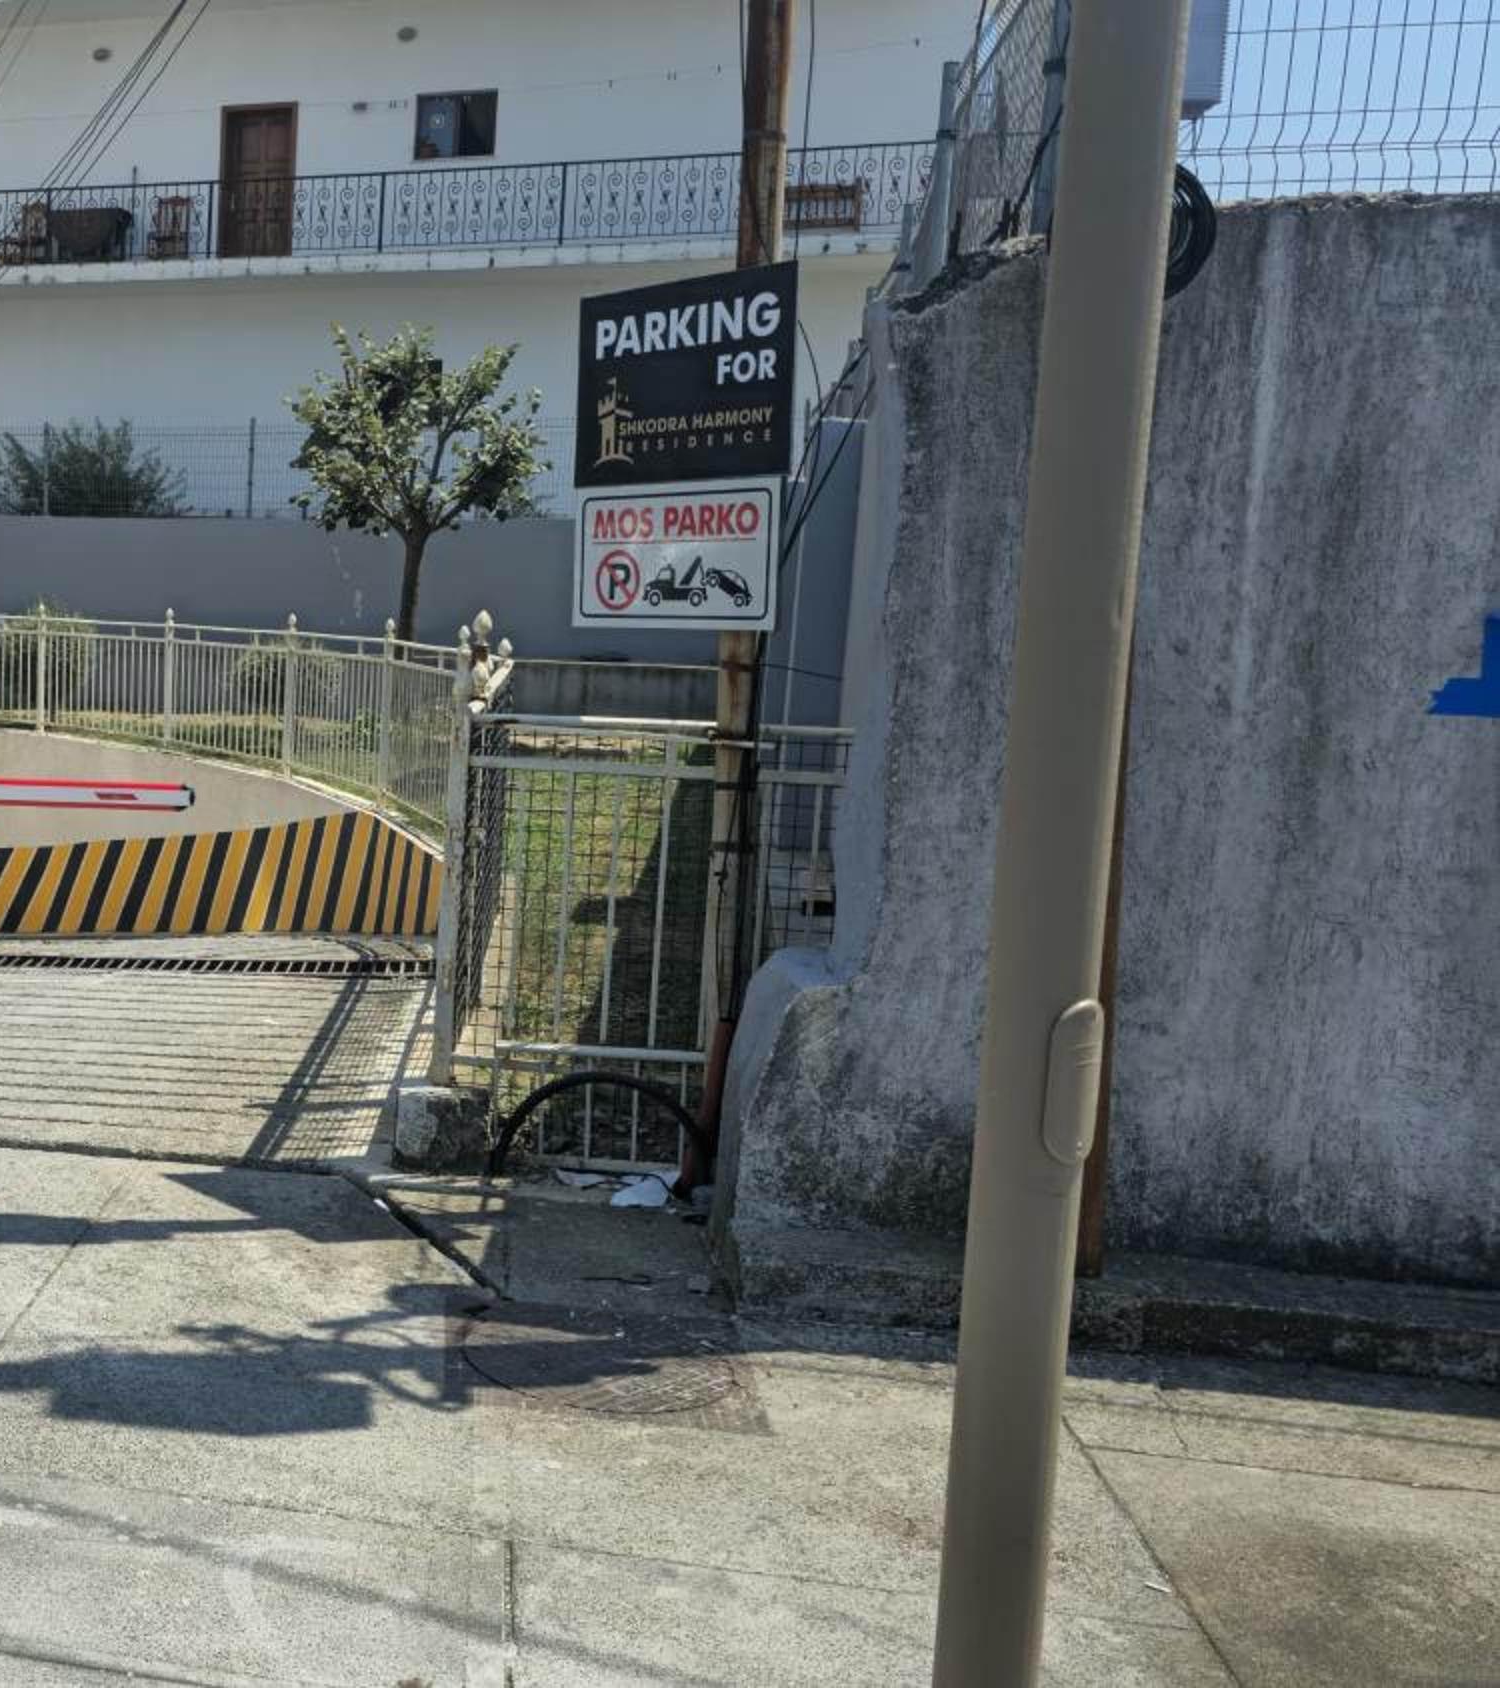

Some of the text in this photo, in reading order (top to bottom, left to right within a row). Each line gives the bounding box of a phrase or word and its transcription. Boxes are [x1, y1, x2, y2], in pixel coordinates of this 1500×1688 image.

[595, 291, 781, 360] PARKING
[716, 349, 777, 385] FOR
[619, 406, 773, 436] SHKODRA HARMONY
[593, 502, 760, 539] MOS PARKO
